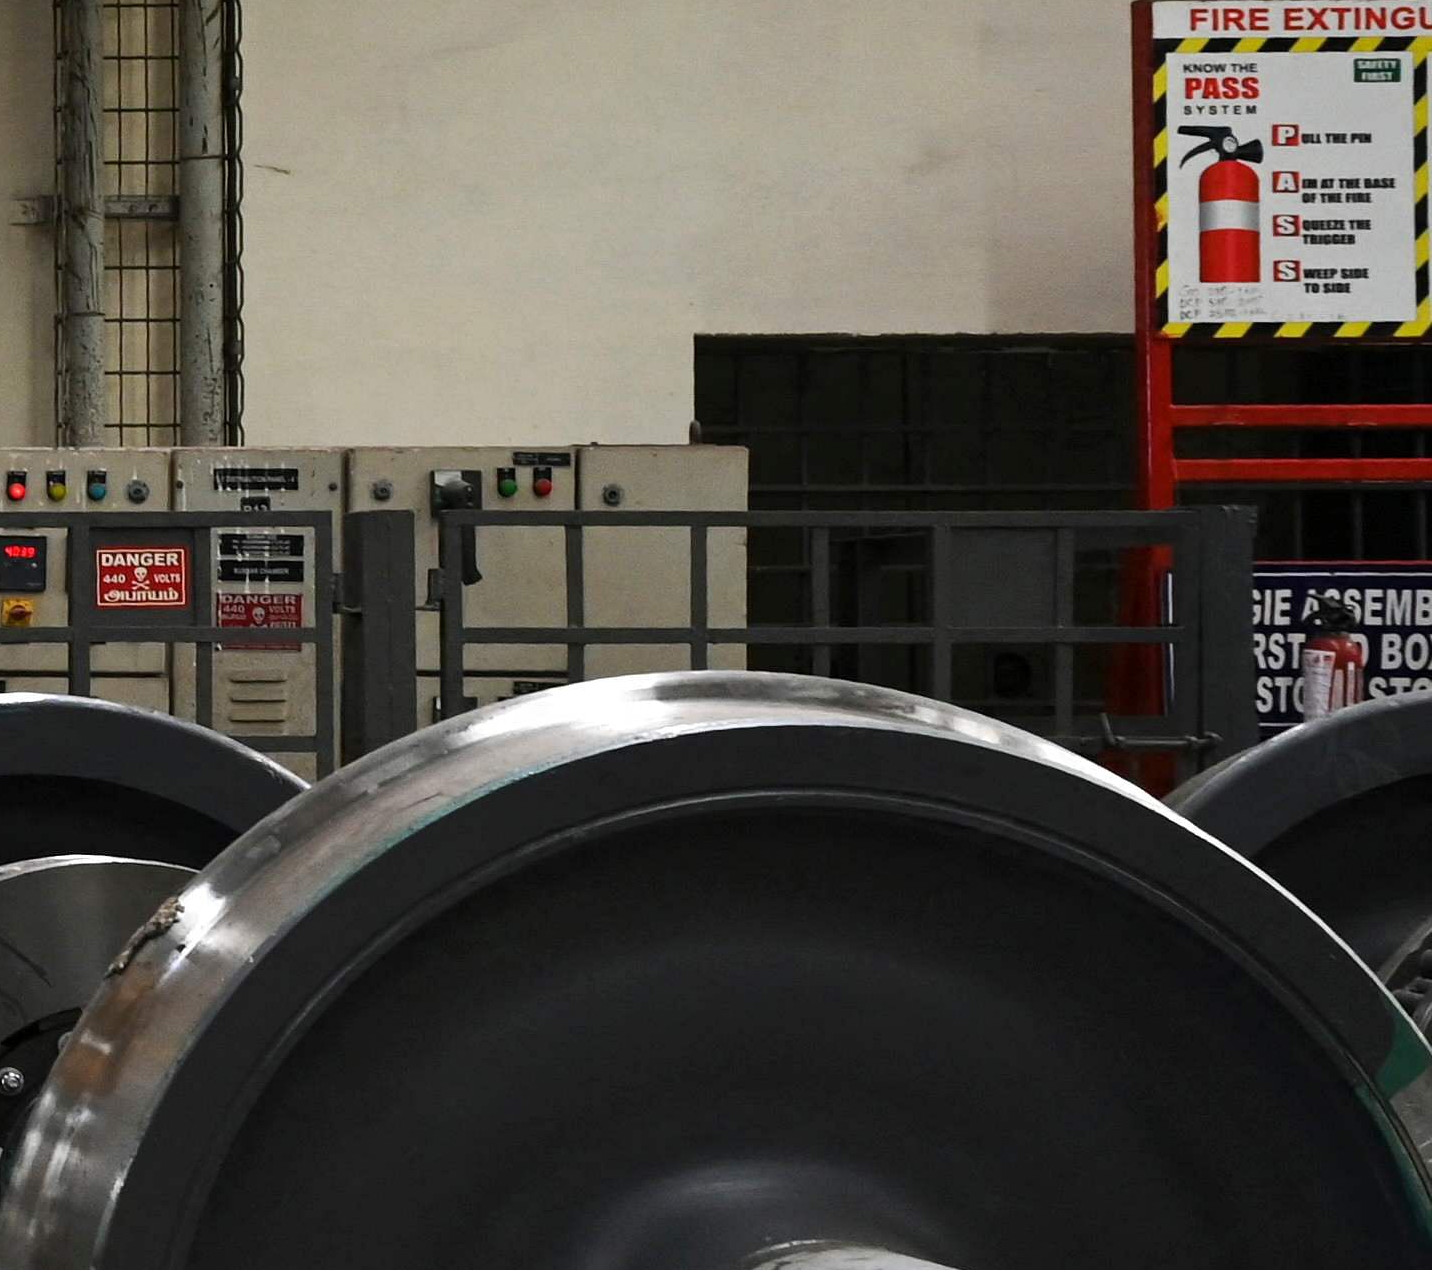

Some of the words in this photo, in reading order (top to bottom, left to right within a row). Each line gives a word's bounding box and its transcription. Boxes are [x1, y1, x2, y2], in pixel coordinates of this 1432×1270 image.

[1190, 8, 1270, 31] FIRE
[1183, 64, 1228, 73] KNOW
[1231, 63, 1257, 73] THE
[1185, 77, 1259, 99] PASS
[101, 554, 179, 566] DANGER
[103, 574, 126, 584] 440
[154, 574, 180, 584] VOLTS
[222, 595, 296, 604] DANGER
[224, 605, 245, 613] 440
